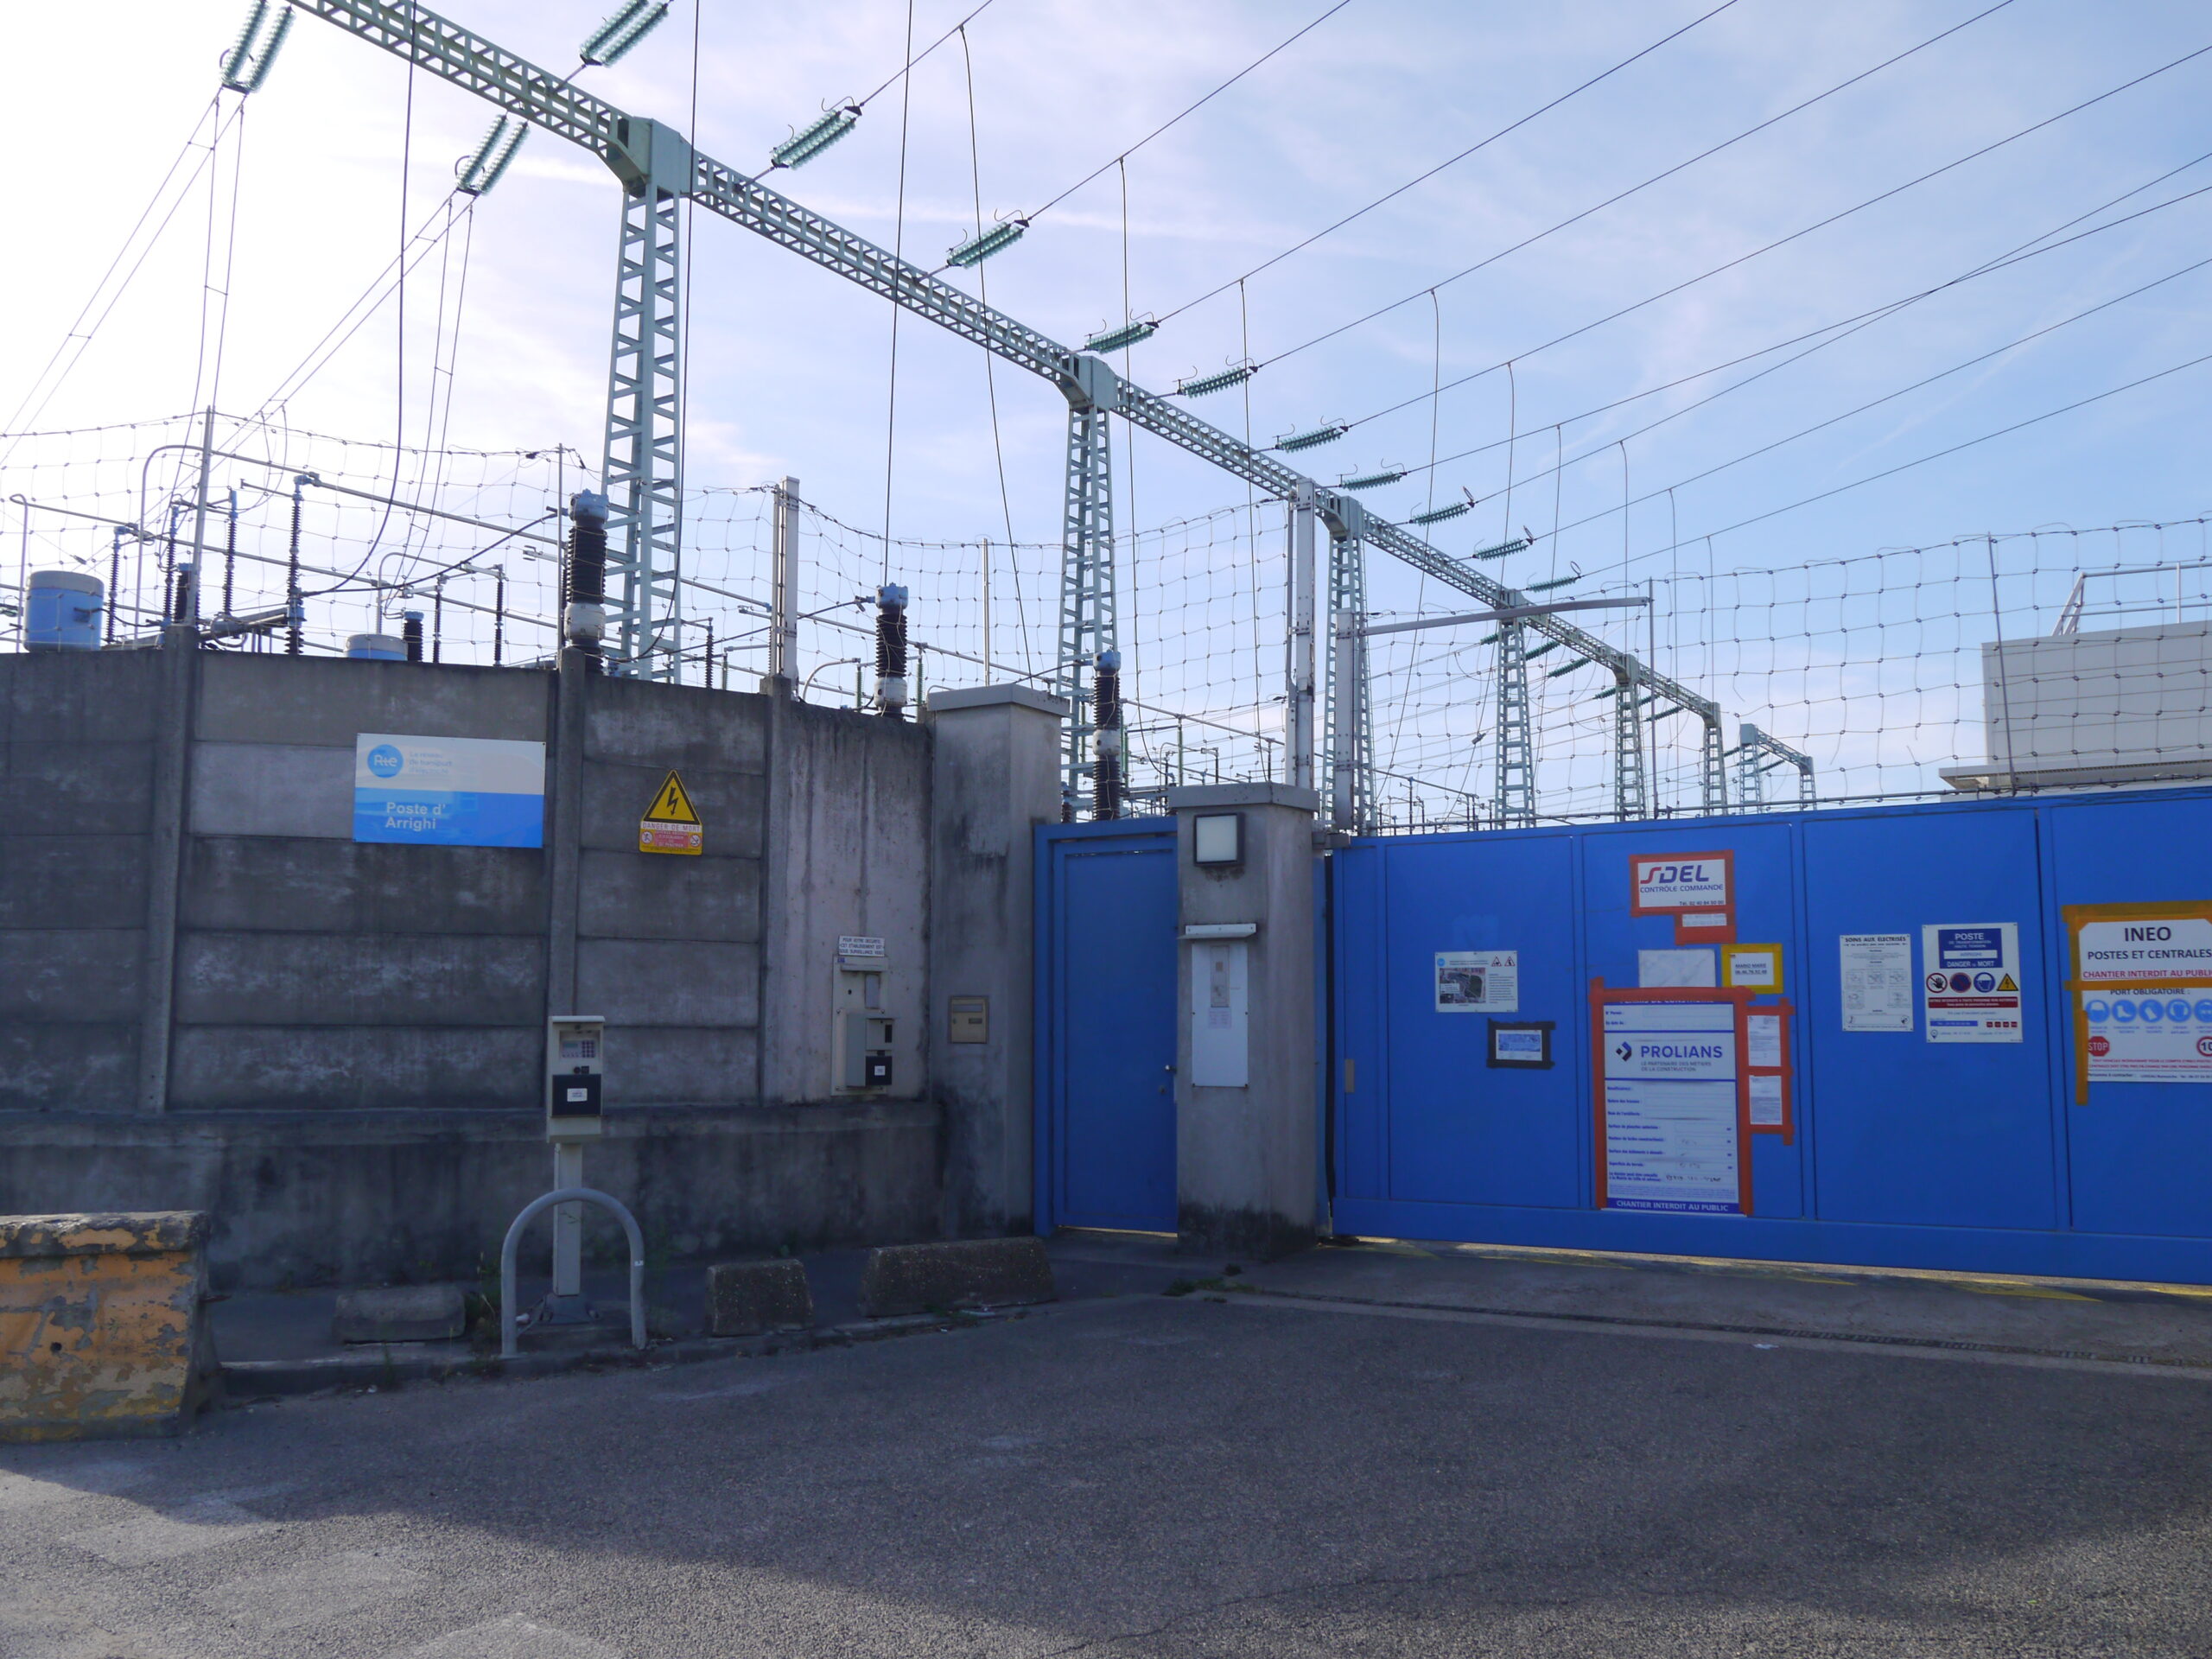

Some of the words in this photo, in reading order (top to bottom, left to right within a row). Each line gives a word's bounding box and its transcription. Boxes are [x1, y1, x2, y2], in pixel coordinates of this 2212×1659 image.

[387, 803, 429, 816] Poste
[434, 804, 446, 816] d'
[385, 817, 436, 832] Arrighi
[643, 822, 669, 830] DANGER
[1640, 865, 1710, 884] SDEL
[1640, 885, 1679, 893] CONTRÔLE
[1680, 884, 1724, 893] COMMANDE
[1955, 932, 1985, 941] POSTE
[2124, 926, 2172, 942] INEO
[2088, 950, 2129, 961] POSTES
[2132, 950, 2145, 959] ET
[2147, 948, 2212, 959] CENTRALES
[2082, 970, 2126, 979] CHANTIER
[2128, 969, 2167, 978] INTERDIT
[1641, 1046, 1723, 1059] PROLIANS
[2088, 1042, 2109, 1052] STOP
[1617, 1200, 1651, 1209] CHANTIER
[1653, 1201, 1686, 1210] INTERDIT
[1701, 1204, 1729, 1212] PUBLIC
